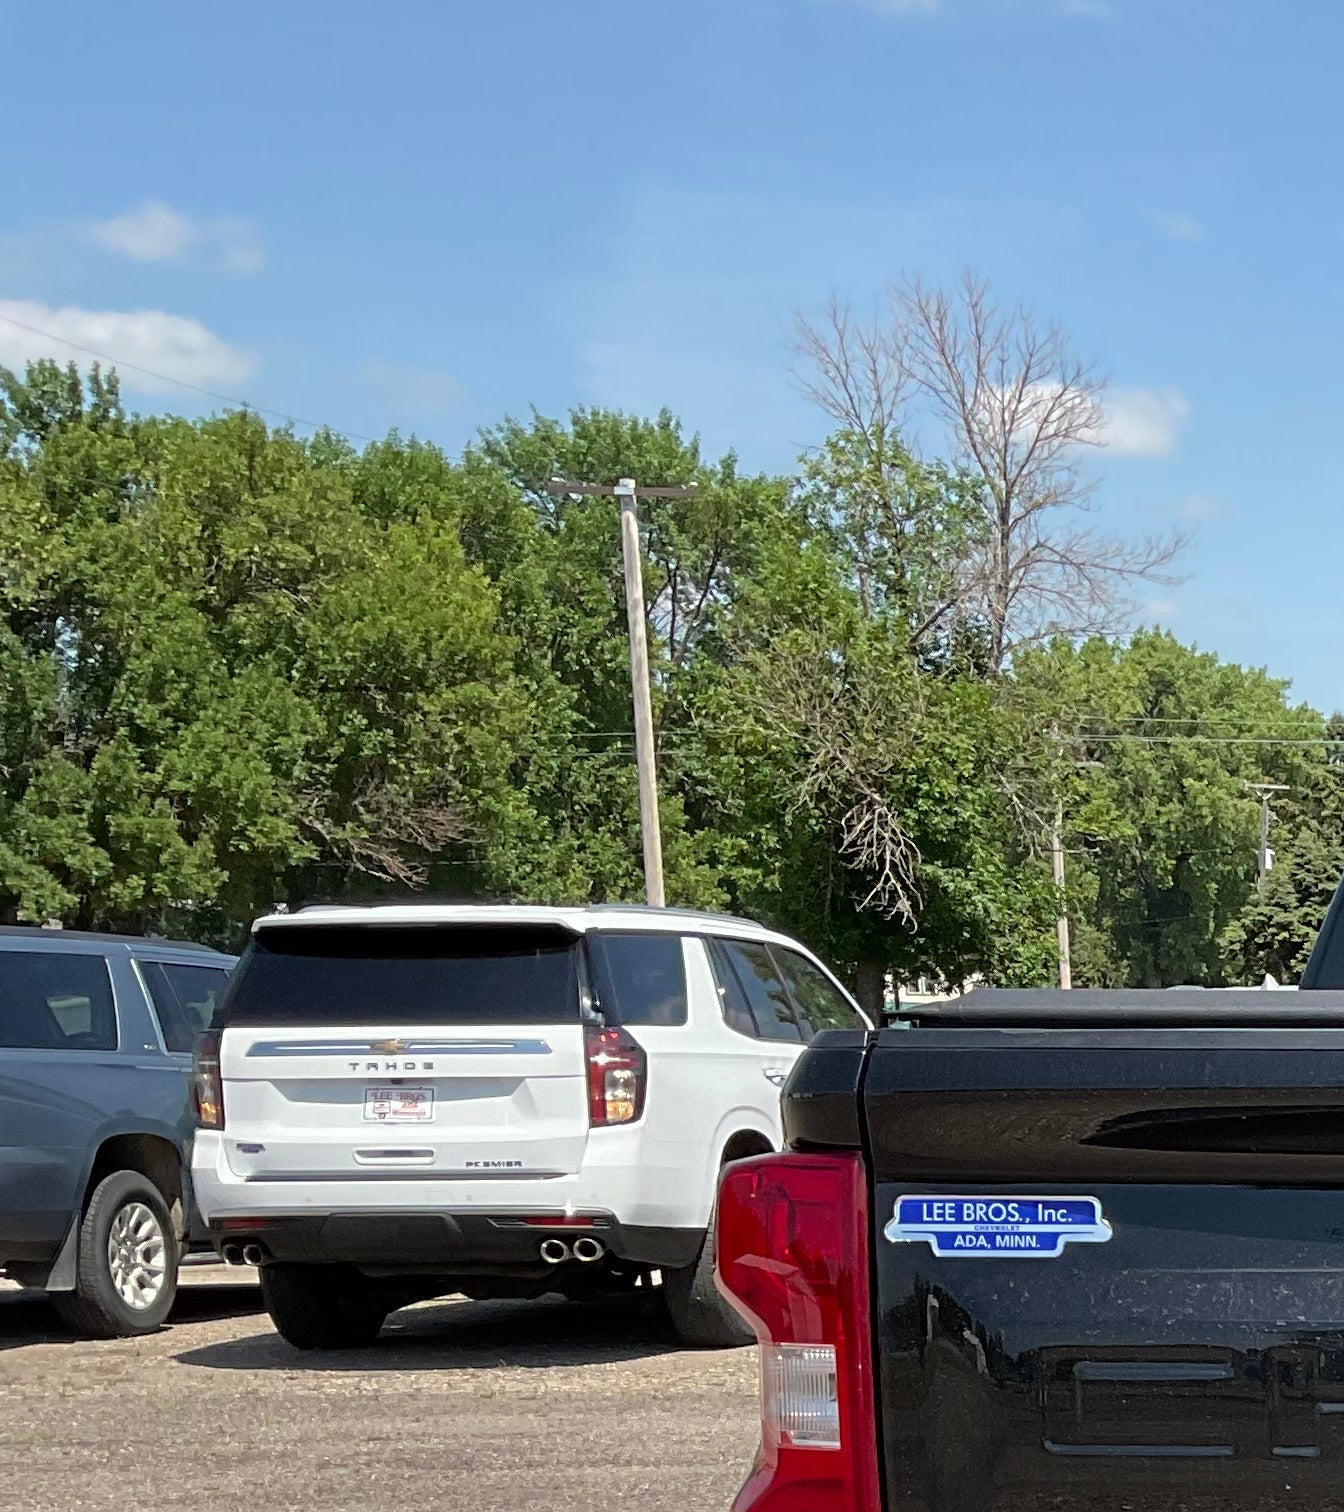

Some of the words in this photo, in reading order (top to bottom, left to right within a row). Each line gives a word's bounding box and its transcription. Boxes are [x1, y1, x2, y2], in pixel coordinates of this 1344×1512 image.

[349, 1062, 434, 1071] TAHOE
[922, 1202, 956, 1222] LEE
[1037, 1203, 1073, 1222] Inc.
[953, 1234, 992, 1248] ADA,
[995, 1234, 1041, 1248] MINN.
